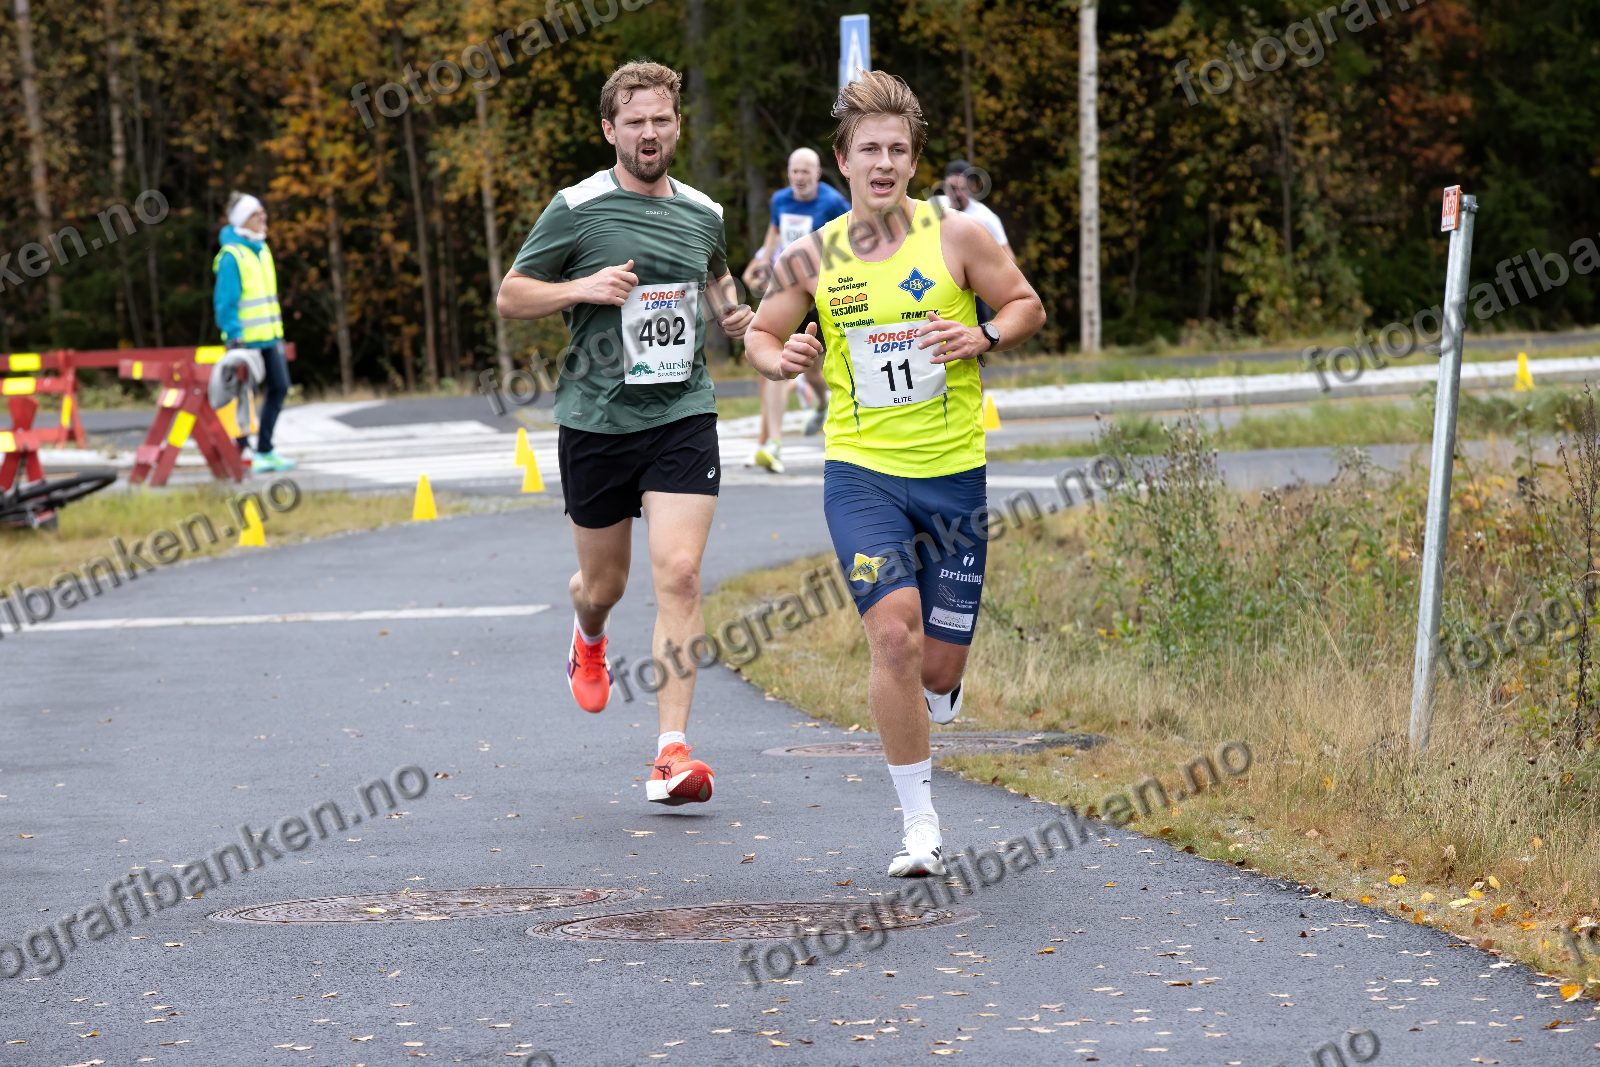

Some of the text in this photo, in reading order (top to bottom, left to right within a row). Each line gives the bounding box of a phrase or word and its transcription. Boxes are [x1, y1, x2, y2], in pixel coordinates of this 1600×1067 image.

[837, 276, 854, 284] Oslo
[640, 290, 686, 301] NORGES
[645, 300, 680, 310] LØPET
[639, 316, 687, 348] 492
[873, 339, 915, 354] LØPET
[880, 358, 914, 392] 11
[893, 396, 913, 404] ELITE
[939, 568, 983, 584] printing
